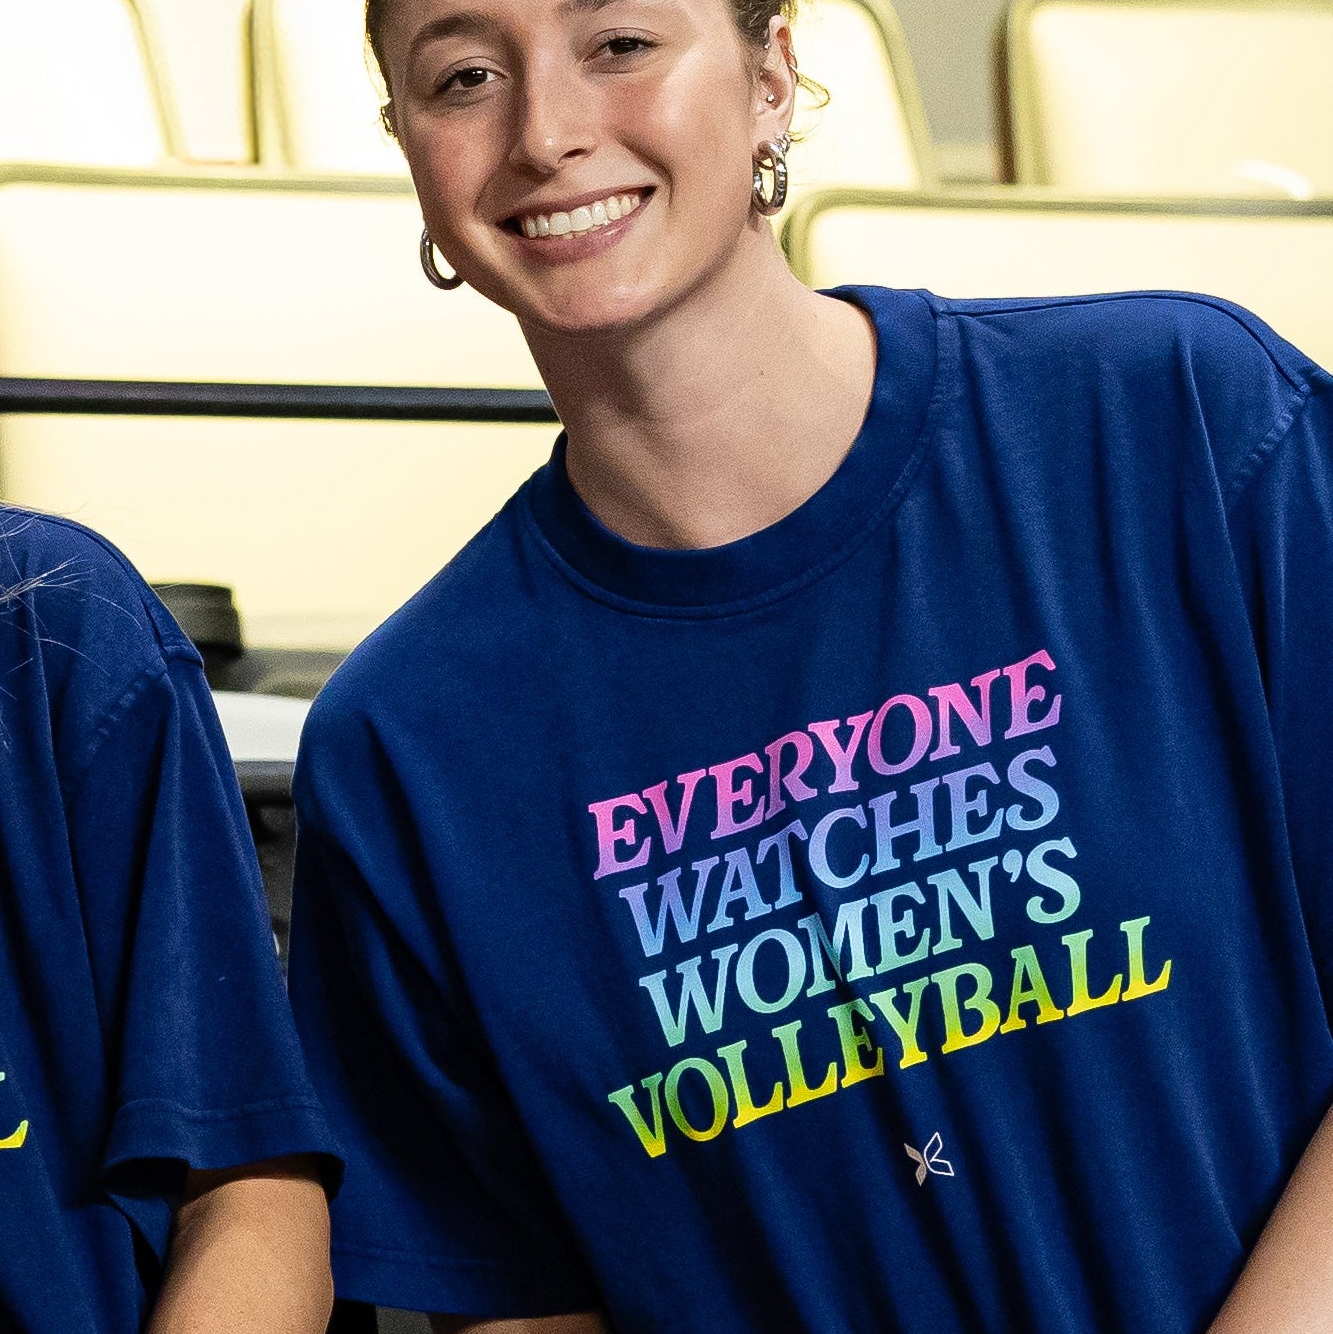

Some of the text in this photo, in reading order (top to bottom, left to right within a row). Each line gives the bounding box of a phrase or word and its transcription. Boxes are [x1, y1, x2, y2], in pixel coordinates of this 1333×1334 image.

[588, 649, 1061, 879] EVERYONE
[619, 745, 1059, 957] WATCHES
[608, 915, 1172, 1158] VOLLEYBALL
[638, 837, 1081, 1047] WOMEN'S
